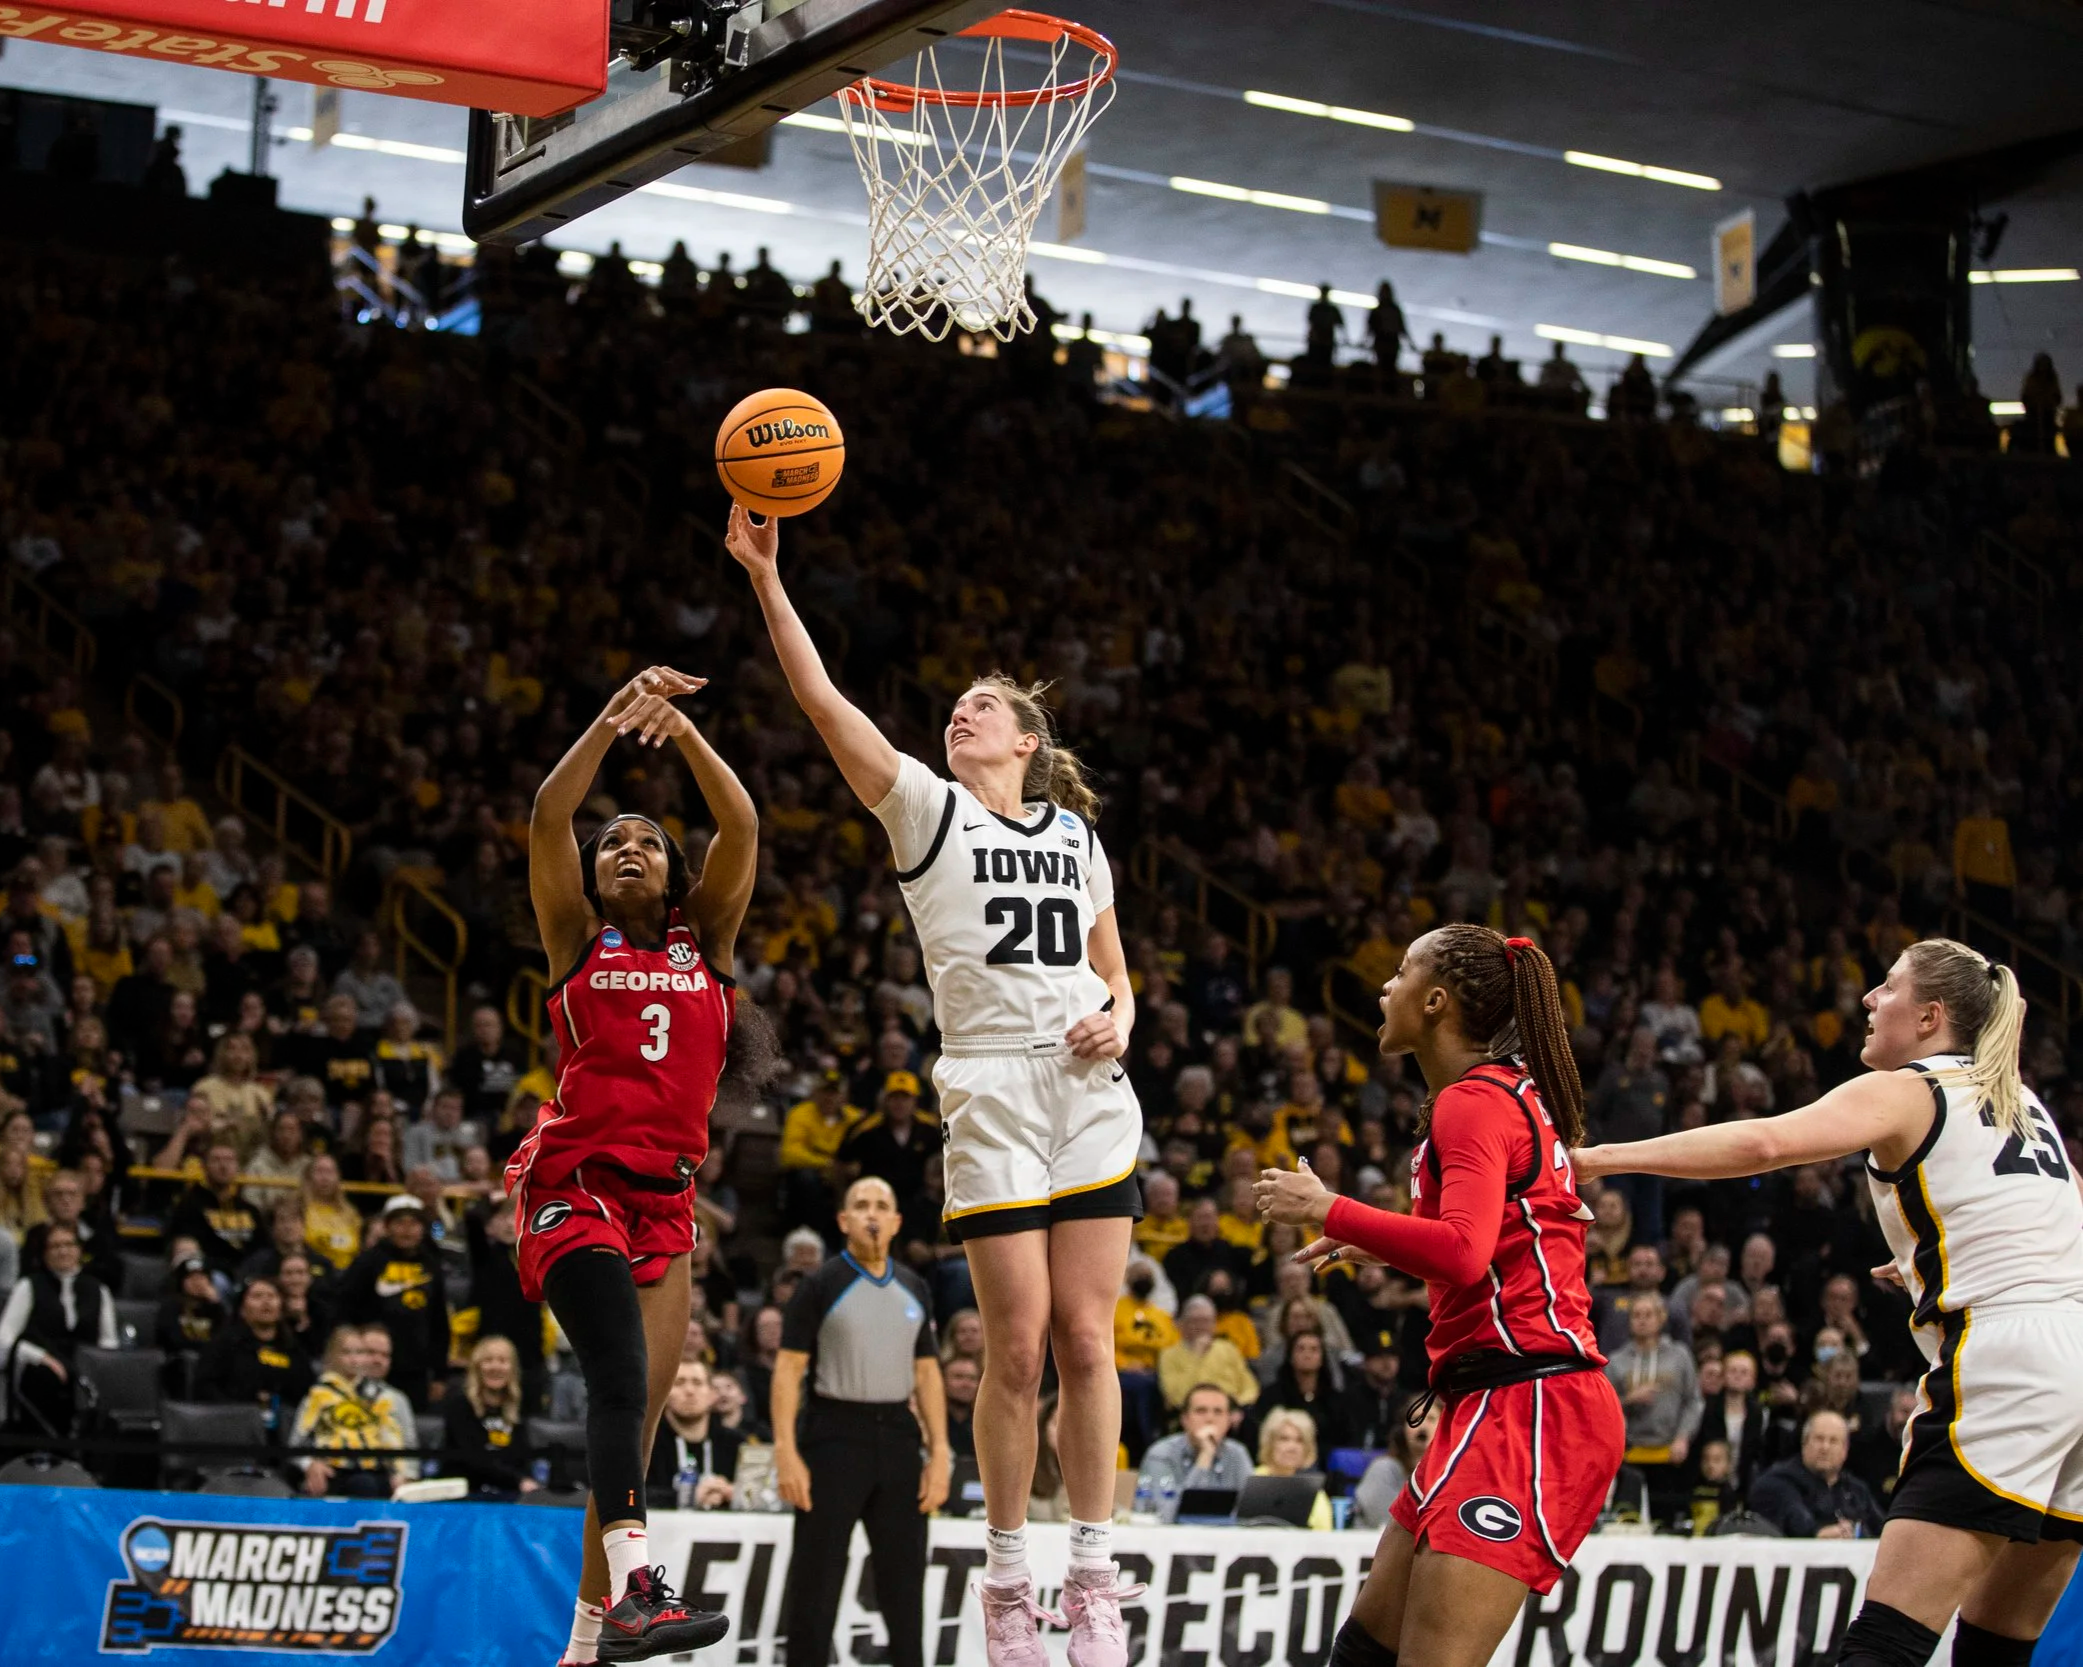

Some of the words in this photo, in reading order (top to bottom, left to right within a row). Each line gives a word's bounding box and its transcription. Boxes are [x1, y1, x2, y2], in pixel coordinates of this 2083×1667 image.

[746, 418, 830, 448] Wilson
[783, 466, 808, 477] MARCH
[786, 472, 819, 484] MADNESS
[973, 848, 1081, 891] IOWA
[668, 942, 693, 964] SEC
[984, 897, 1082, 966] 20
[589, 971, 709, 992] GEORGIA
[640, 1003, 671, 1062] 3
[1457, 1495, 1523, 1541] G
[170, 1531, 327, 1584] MARCH
[190, 1582, 395, 1633] MADNESS
